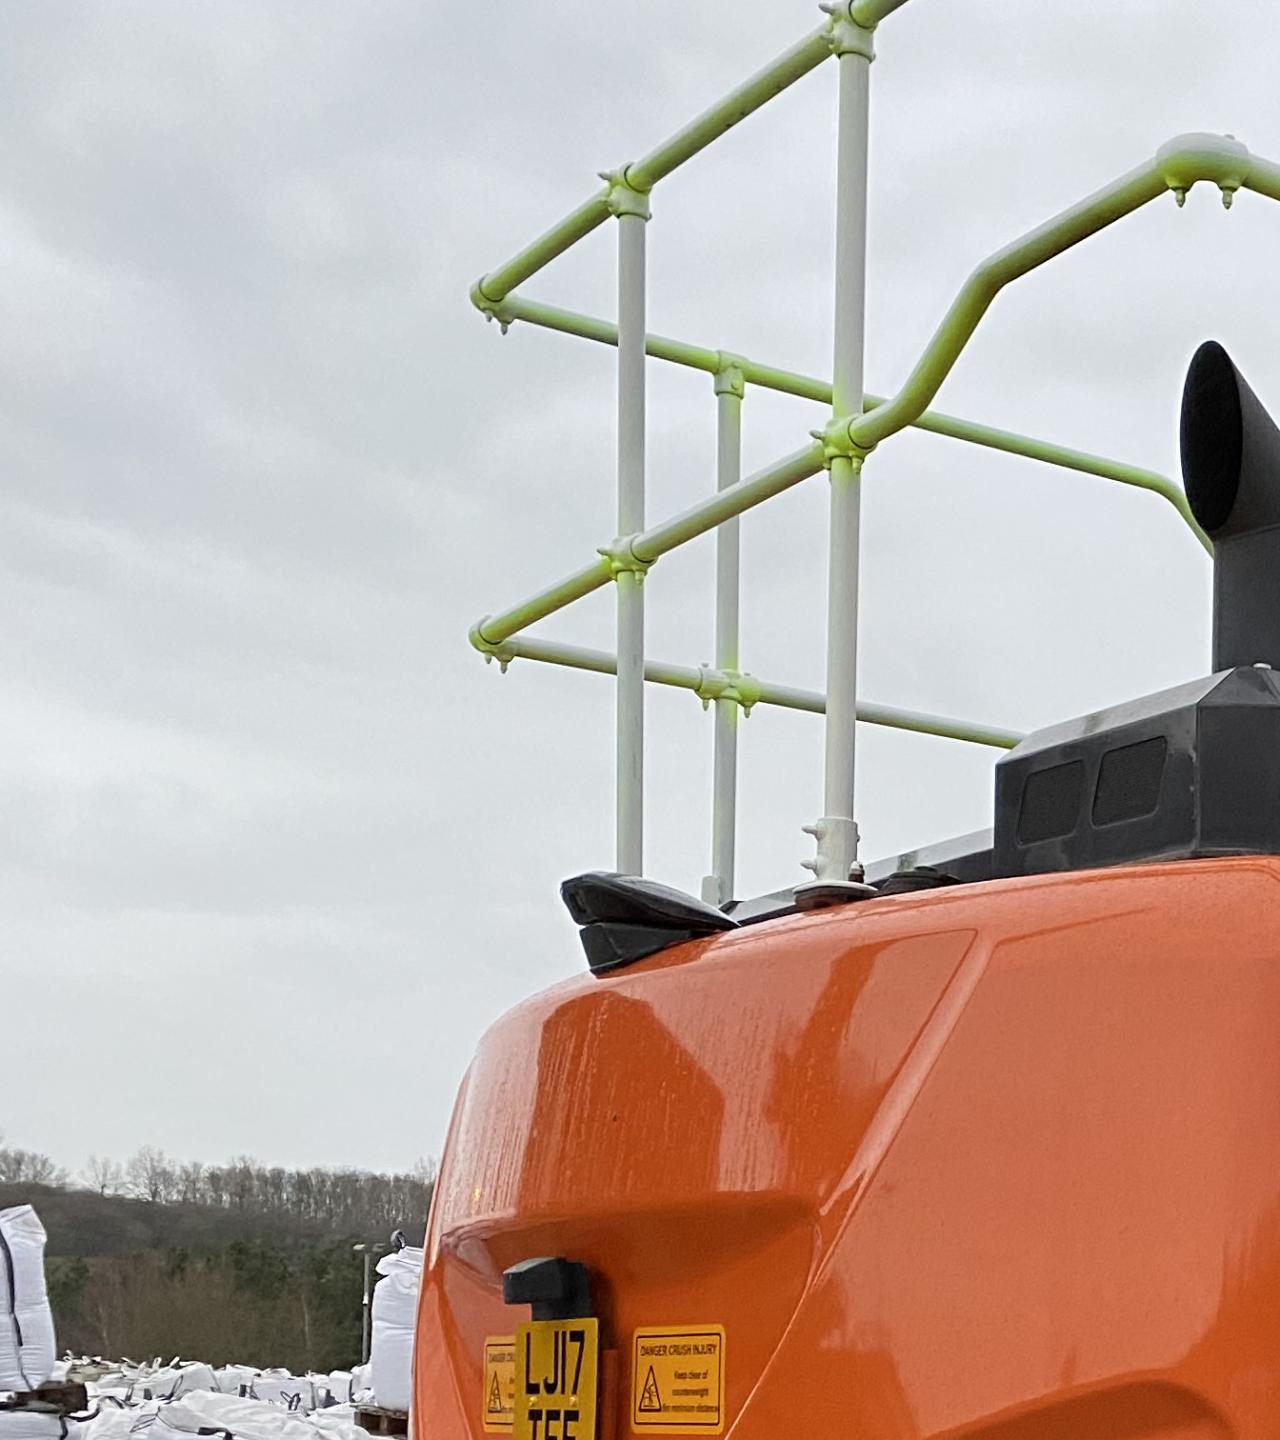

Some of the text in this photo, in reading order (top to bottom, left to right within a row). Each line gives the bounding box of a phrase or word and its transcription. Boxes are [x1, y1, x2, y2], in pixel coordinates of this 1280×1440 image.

[525, 1330, 585, 1395] LJ17
[640, 1344, 667, 1356] DANGER
[668, 1344, 691, 1356] CRUSH
